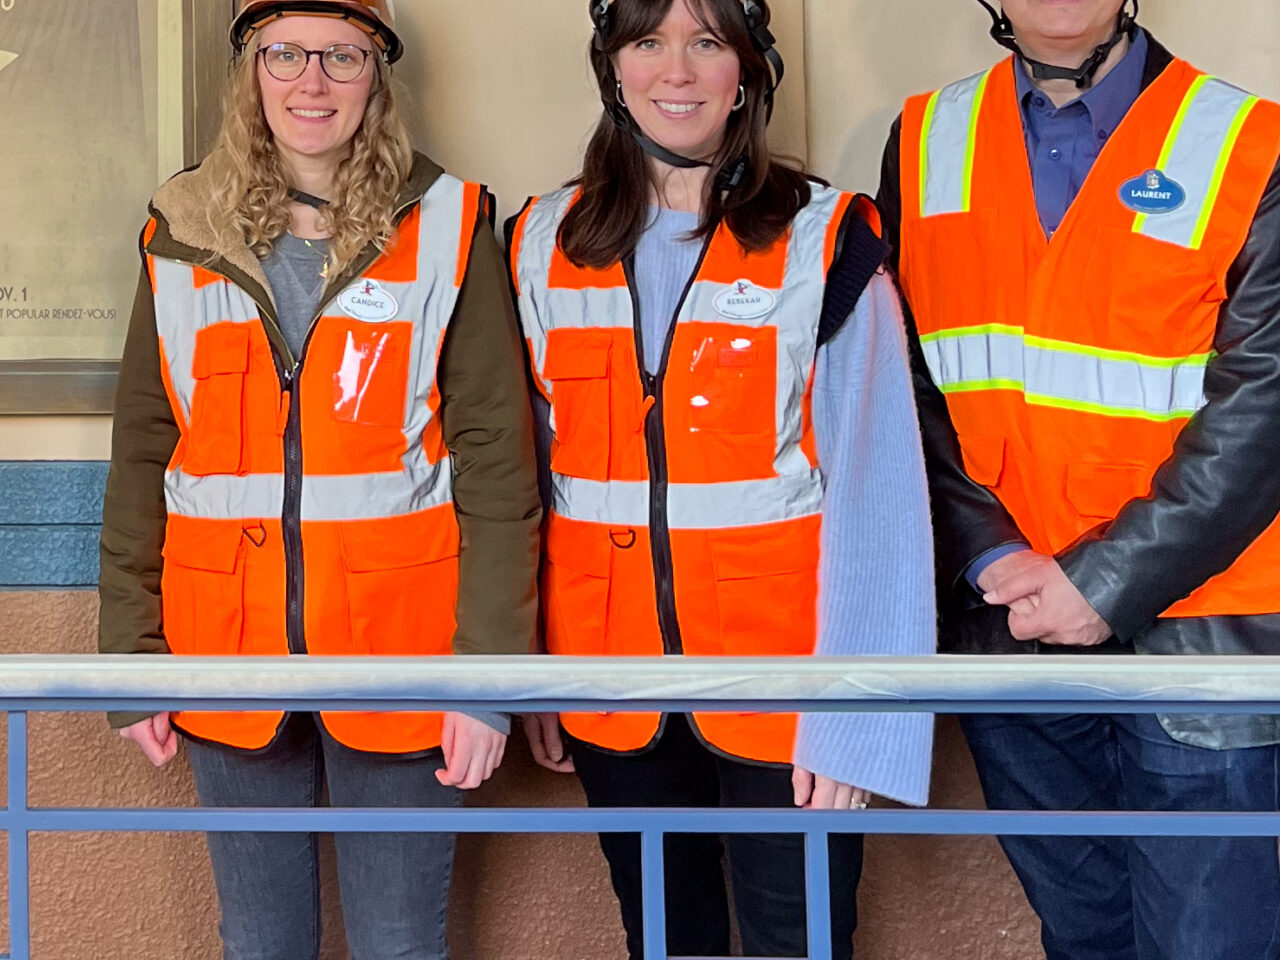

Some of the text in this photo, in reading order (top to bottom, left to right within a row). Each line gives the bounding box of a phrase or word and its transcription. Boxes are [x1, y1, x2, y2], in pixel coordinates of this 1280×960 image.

[1131, 189, 1172, 200] LAURENT
[21, 286, 28, 301] 1
[351, 296, 385, 309] CANDICE
[6, 308, 50, 320] POPULAR
